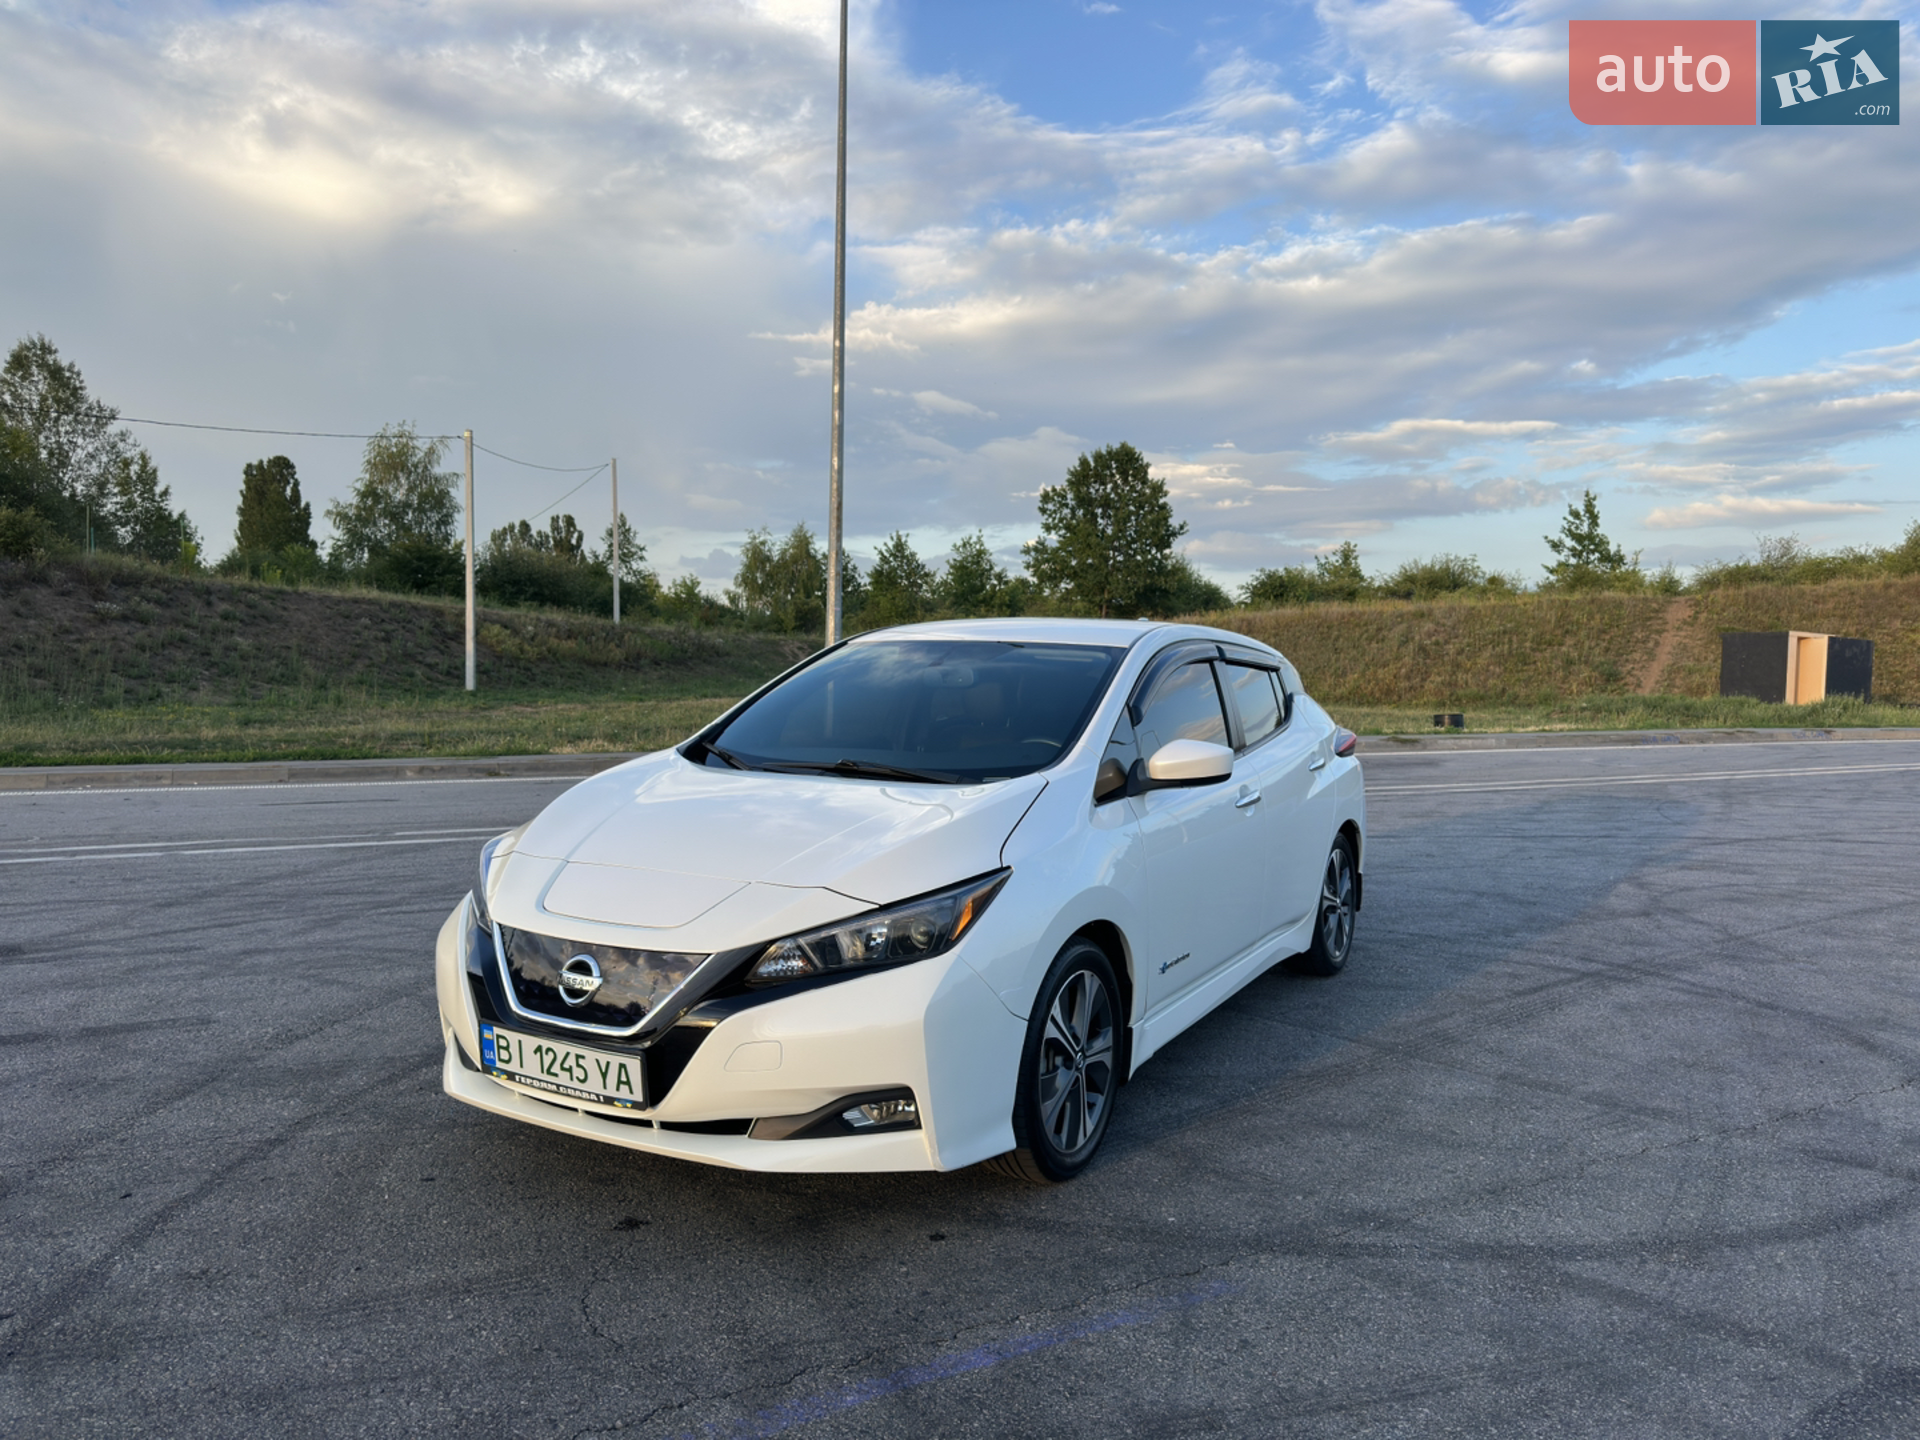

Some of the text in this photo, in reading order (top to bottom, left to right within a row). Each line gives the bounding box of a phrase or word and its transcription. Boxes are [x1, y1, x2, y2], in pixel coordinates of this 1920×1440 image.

[485, 1050, 495, 1059] UA
[496, 1033, 633, 1095] BI 1245 YA
[514, 1074, 558, 1091] ГЕРОЯМ
